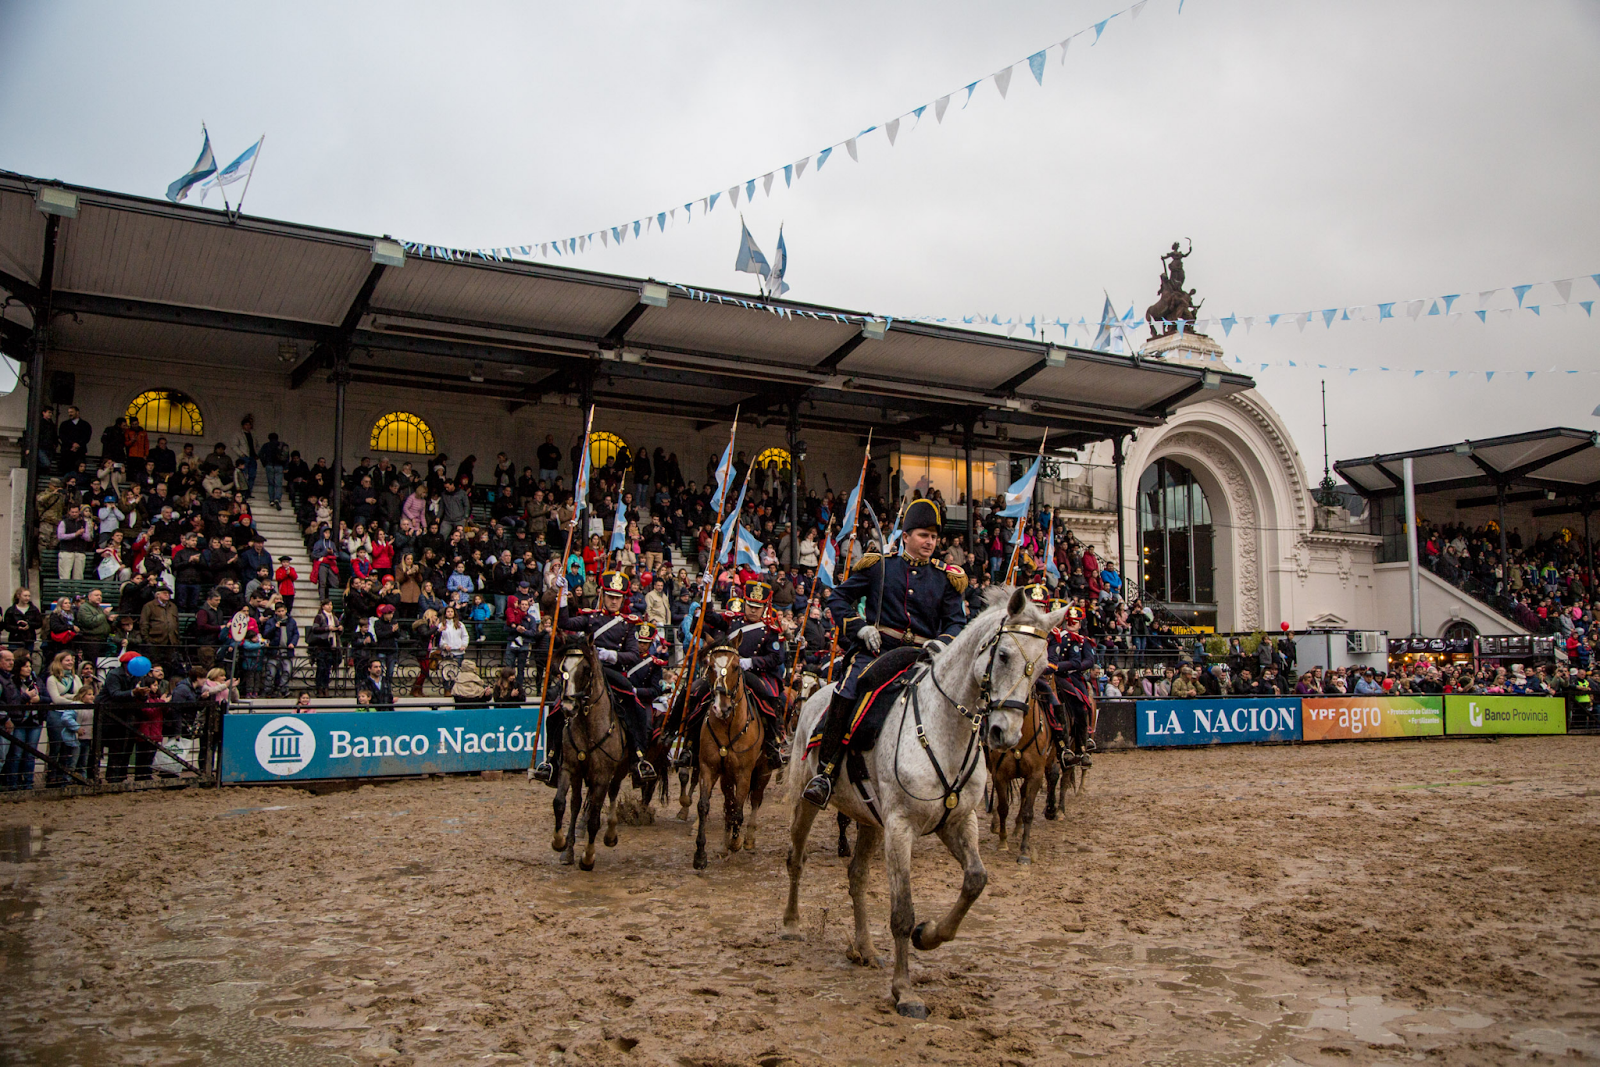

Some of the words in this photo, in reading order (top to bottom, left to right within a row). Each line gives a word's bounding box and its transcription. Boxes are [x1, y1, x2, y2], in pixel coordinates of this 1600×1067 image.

[232, 614, 247, 628] PISTA
[237, 623, 242, 635] 2
[1145, 710, 1185, 735] LA
[1193, 707, 1296, 734] NACION
[1309, 708, 1336, 721] YPF
[1338, 706, 1382, 734] agro
[1484, 708, 1511, 721] Banco
[1512, 708, 1548, 722] Provincia
[329, 730, 430, 759] Banco
[437, 725, 544, 754] Nación
